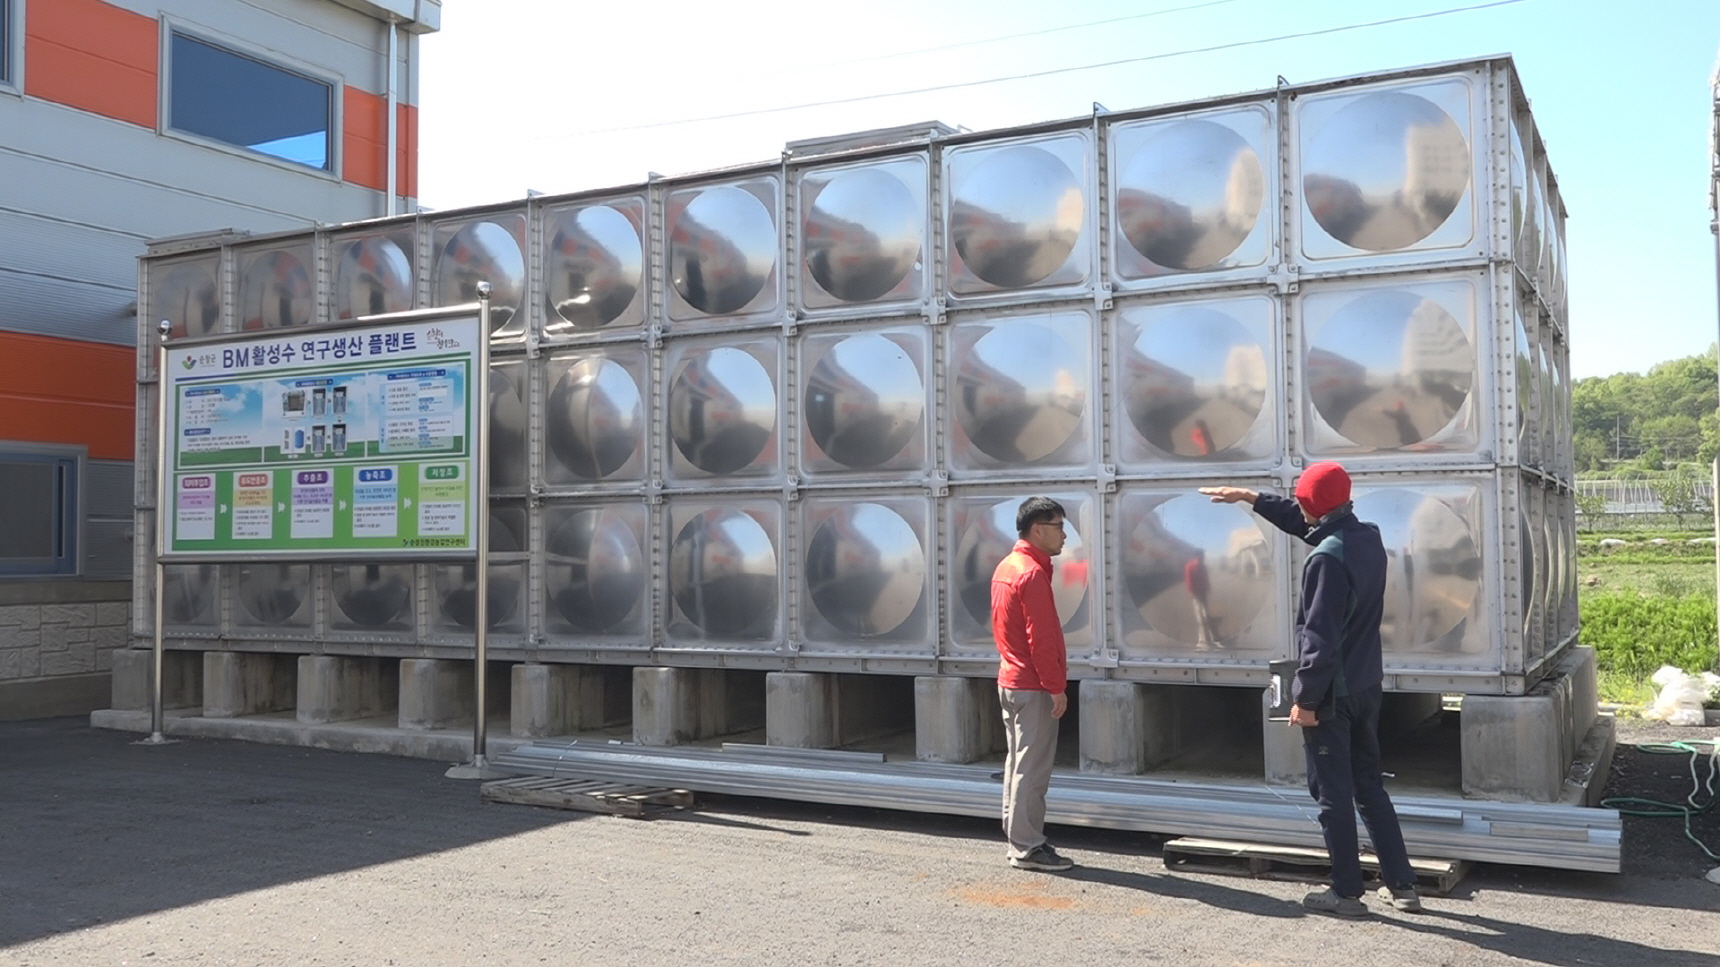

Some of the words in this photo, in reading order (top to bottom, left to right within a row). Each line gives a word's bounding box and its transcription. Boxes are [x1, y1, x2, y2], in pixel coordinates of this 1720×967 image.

[223, 343, 296, 369] BM활성수
[301, 335, 363, 361] 연구생산
[368, 332, 417, 356] 플랜트
[303, 473, 323, 483] 추출조
[365, 470, 386, 481] 농축조
[431, 467, 453, 478] 저장조
